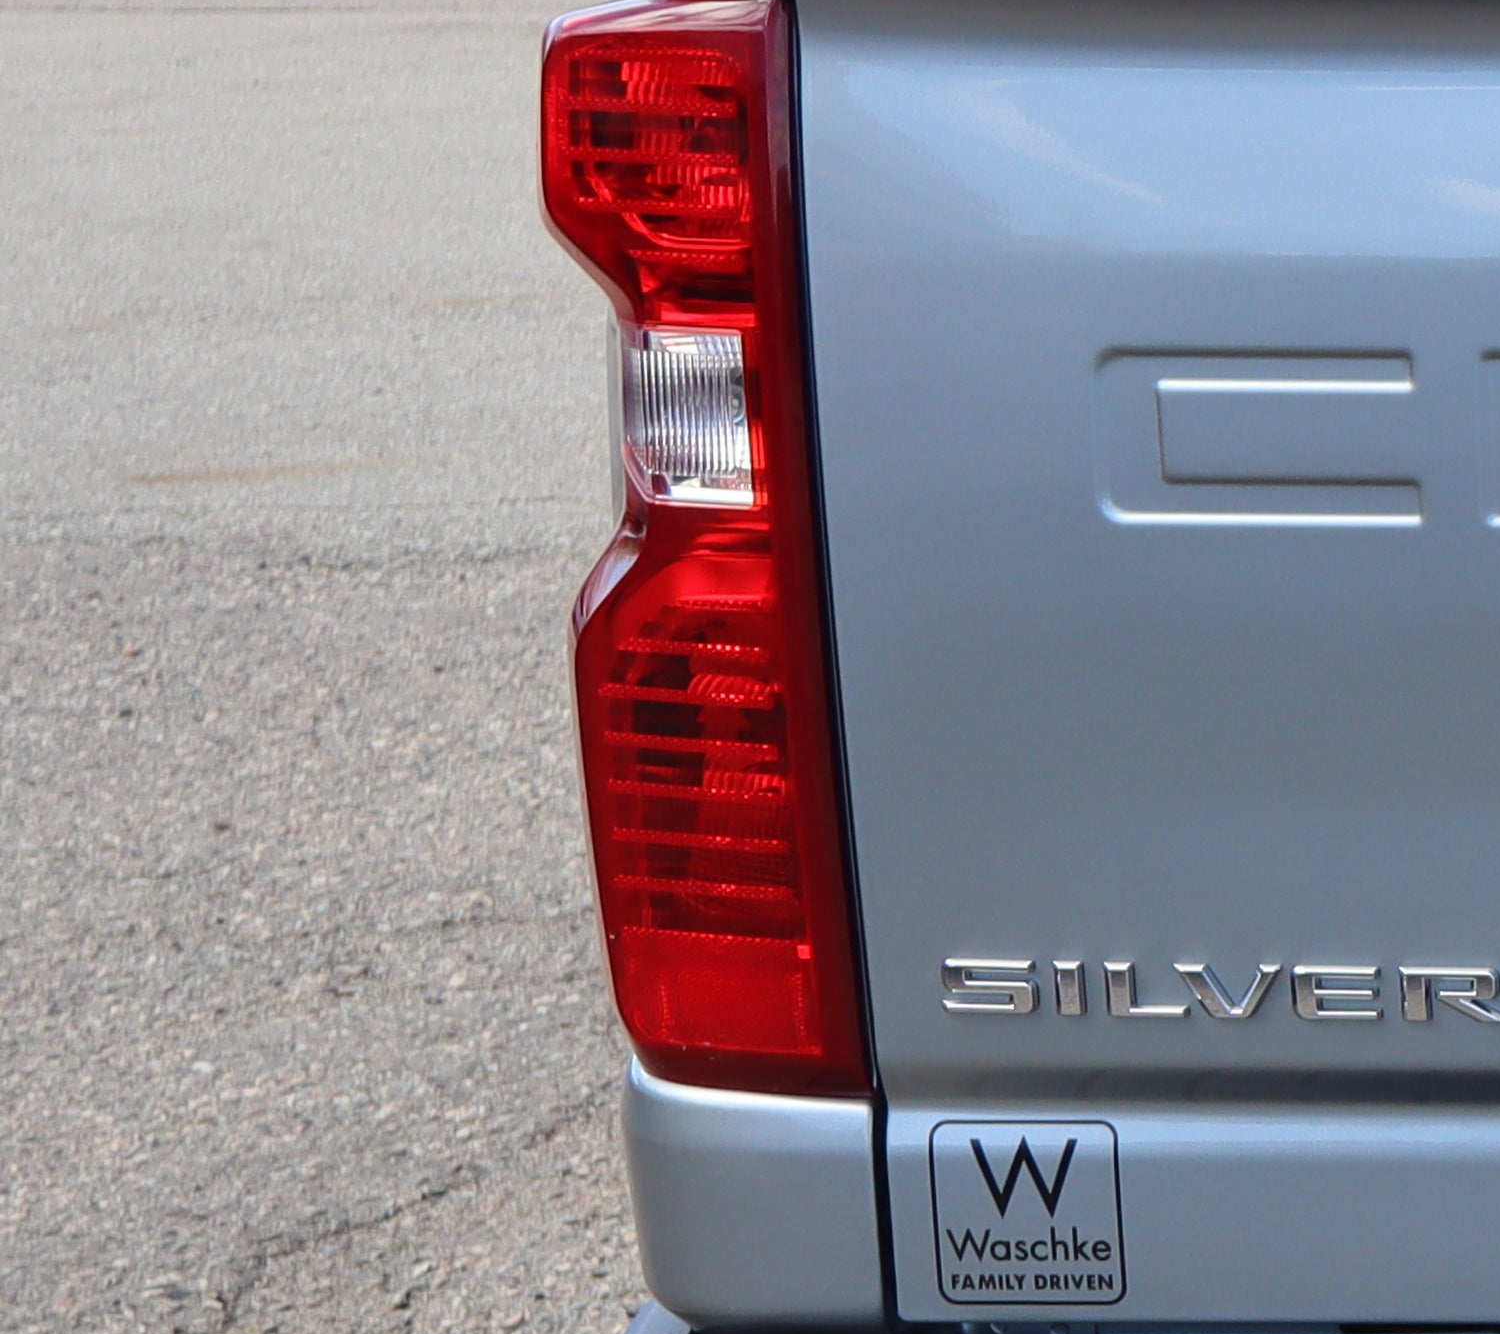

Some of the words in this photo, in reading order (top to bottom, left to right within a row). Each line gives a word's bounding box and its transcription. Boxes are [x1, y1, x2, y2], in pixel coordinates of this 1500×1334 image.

[970, 1135, 1077, 1219] W
[946, 1226, 1112, 1263] Waschke
[950, 1273, 1027, 1291] FAMILY
[1033, 1273, 1114, 1291] DRIVEN
